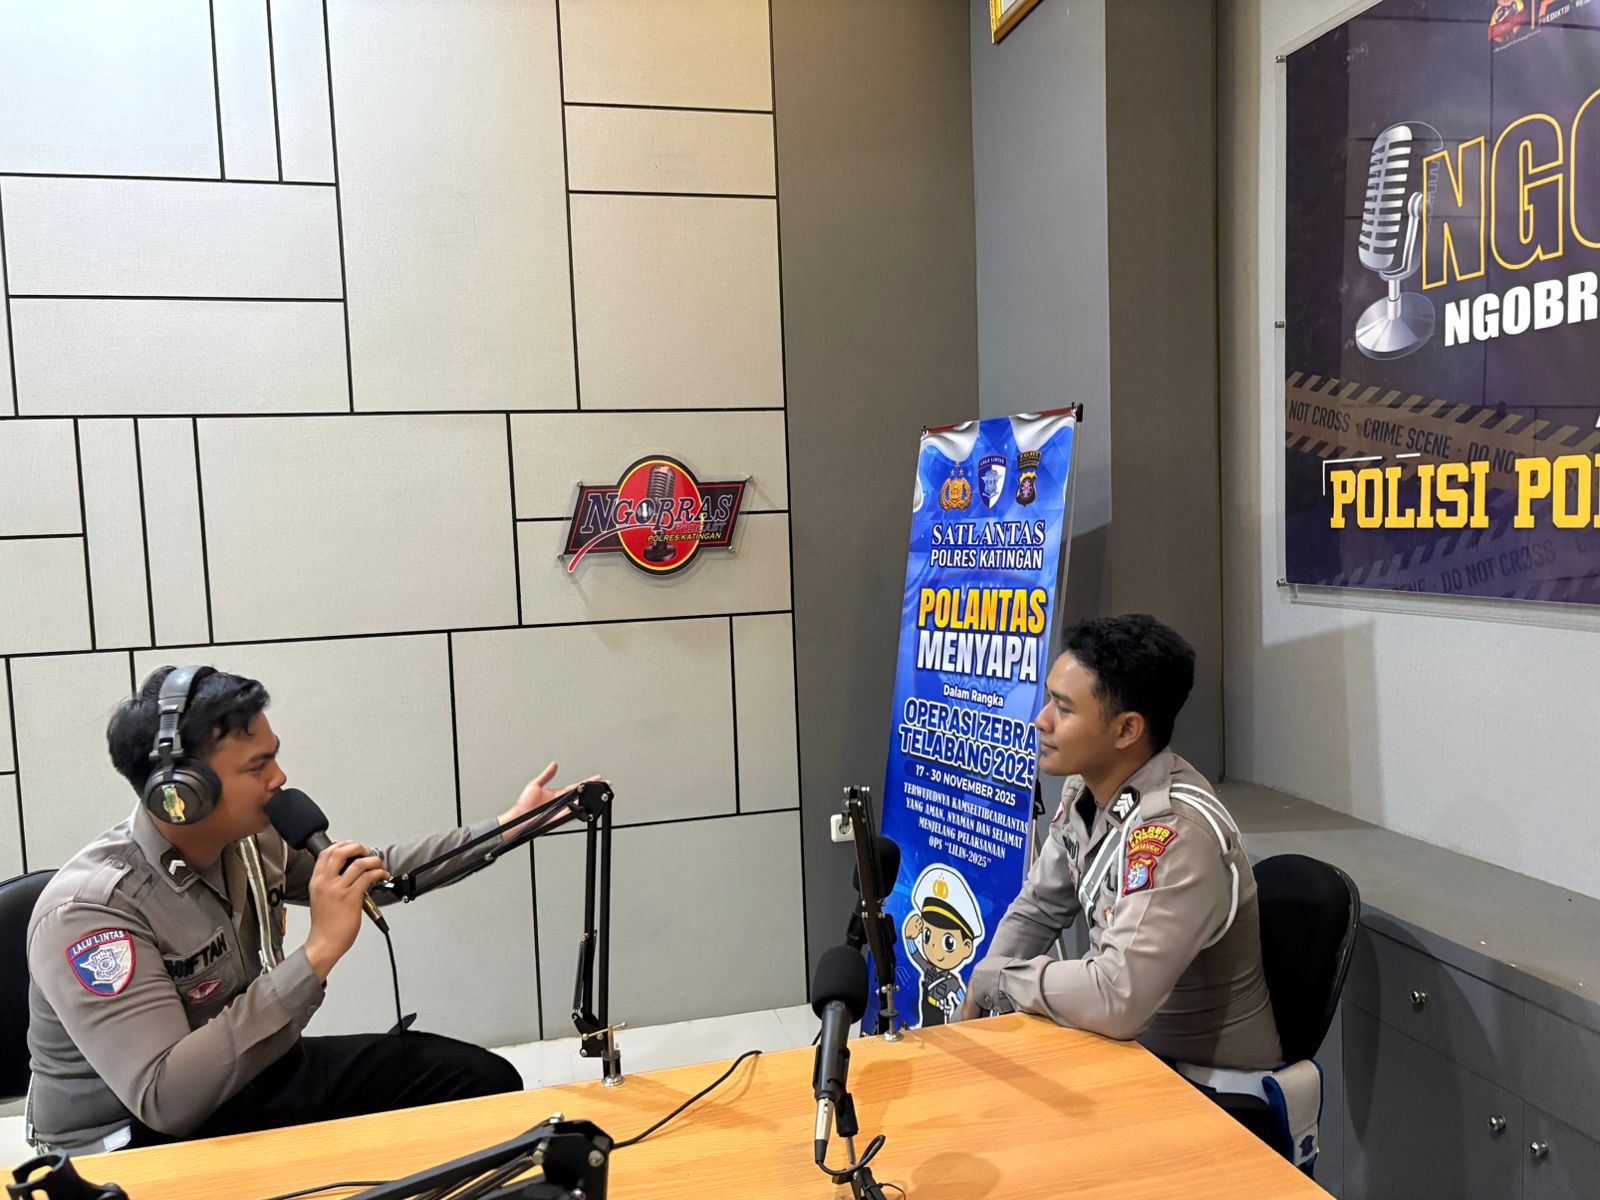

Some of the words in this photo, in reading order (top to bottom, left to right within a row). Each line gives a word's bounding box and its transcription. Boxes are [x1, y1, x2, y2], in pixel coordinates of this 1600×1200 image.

[1444, 271, 1600, 347] NGOBR
[1289, 400, 1311, 422] NOT
[1312, 405, 1351, 432] CROSS
[1363, 417, 1405, 447] CRIME
[1406, 428, 1454, 459] SCENE
[1467, 442, 1490, 463] DO
[580, 492, 733, 534] NGOBRAS
[1330, 461, 1490, 529] POLISI
[647, 534, 680, 542] POLRES
[681, 532, 721, 541] KATINGAN
[931, 520, 1046, 546] SATLANTAS
[930, 549, 976, 569] POLRES
[978, 550, 1043, 570] KATINGAN
[1441, 569, 1463, 593] DO
[1464, 558, 1494, 583] NOT
[1499, 543, 1555, 572] CROSS
[917, 588, 1047, 634] POLANTAS
[917, 630, 1037, 681] MENYAPA
[943, 684, 970, 700] Dalam
[971, 689, 1004, 708] Rangka
[904, 697, 977, 740] OPERASI
[978, 713, 1037, 754] ZEBRA
[899, 724, 993, 775] TELABANG
[915, 765, 925, 776] 17
[930, 769, 941, 781] 30
[943, 773, 994, 799] NOVEMBER
[994, 788, 1016, 806] 2025
[903, 782, 951, 808] TERWUJUDNYA
[951, 794, 1028, 833] KAMSELTIBCARLANTAS
[906, 798, 923, 813] YANG
[924, 804, 945, 822] AMAN,
[947, 809, 975, 831] NYAMAN
[977, 819, 991, 835] DAN
[991, 824, 1023, 849] SELAMAT
[918, 817, 956, 839] MENJELANG
[957, 831, 1006, 859] PELAKSANAAN
[928, 837, 943, 850] OPS
[72, 938, 93, 955] LALU
[94, 930, 125, 943] LINTAS
